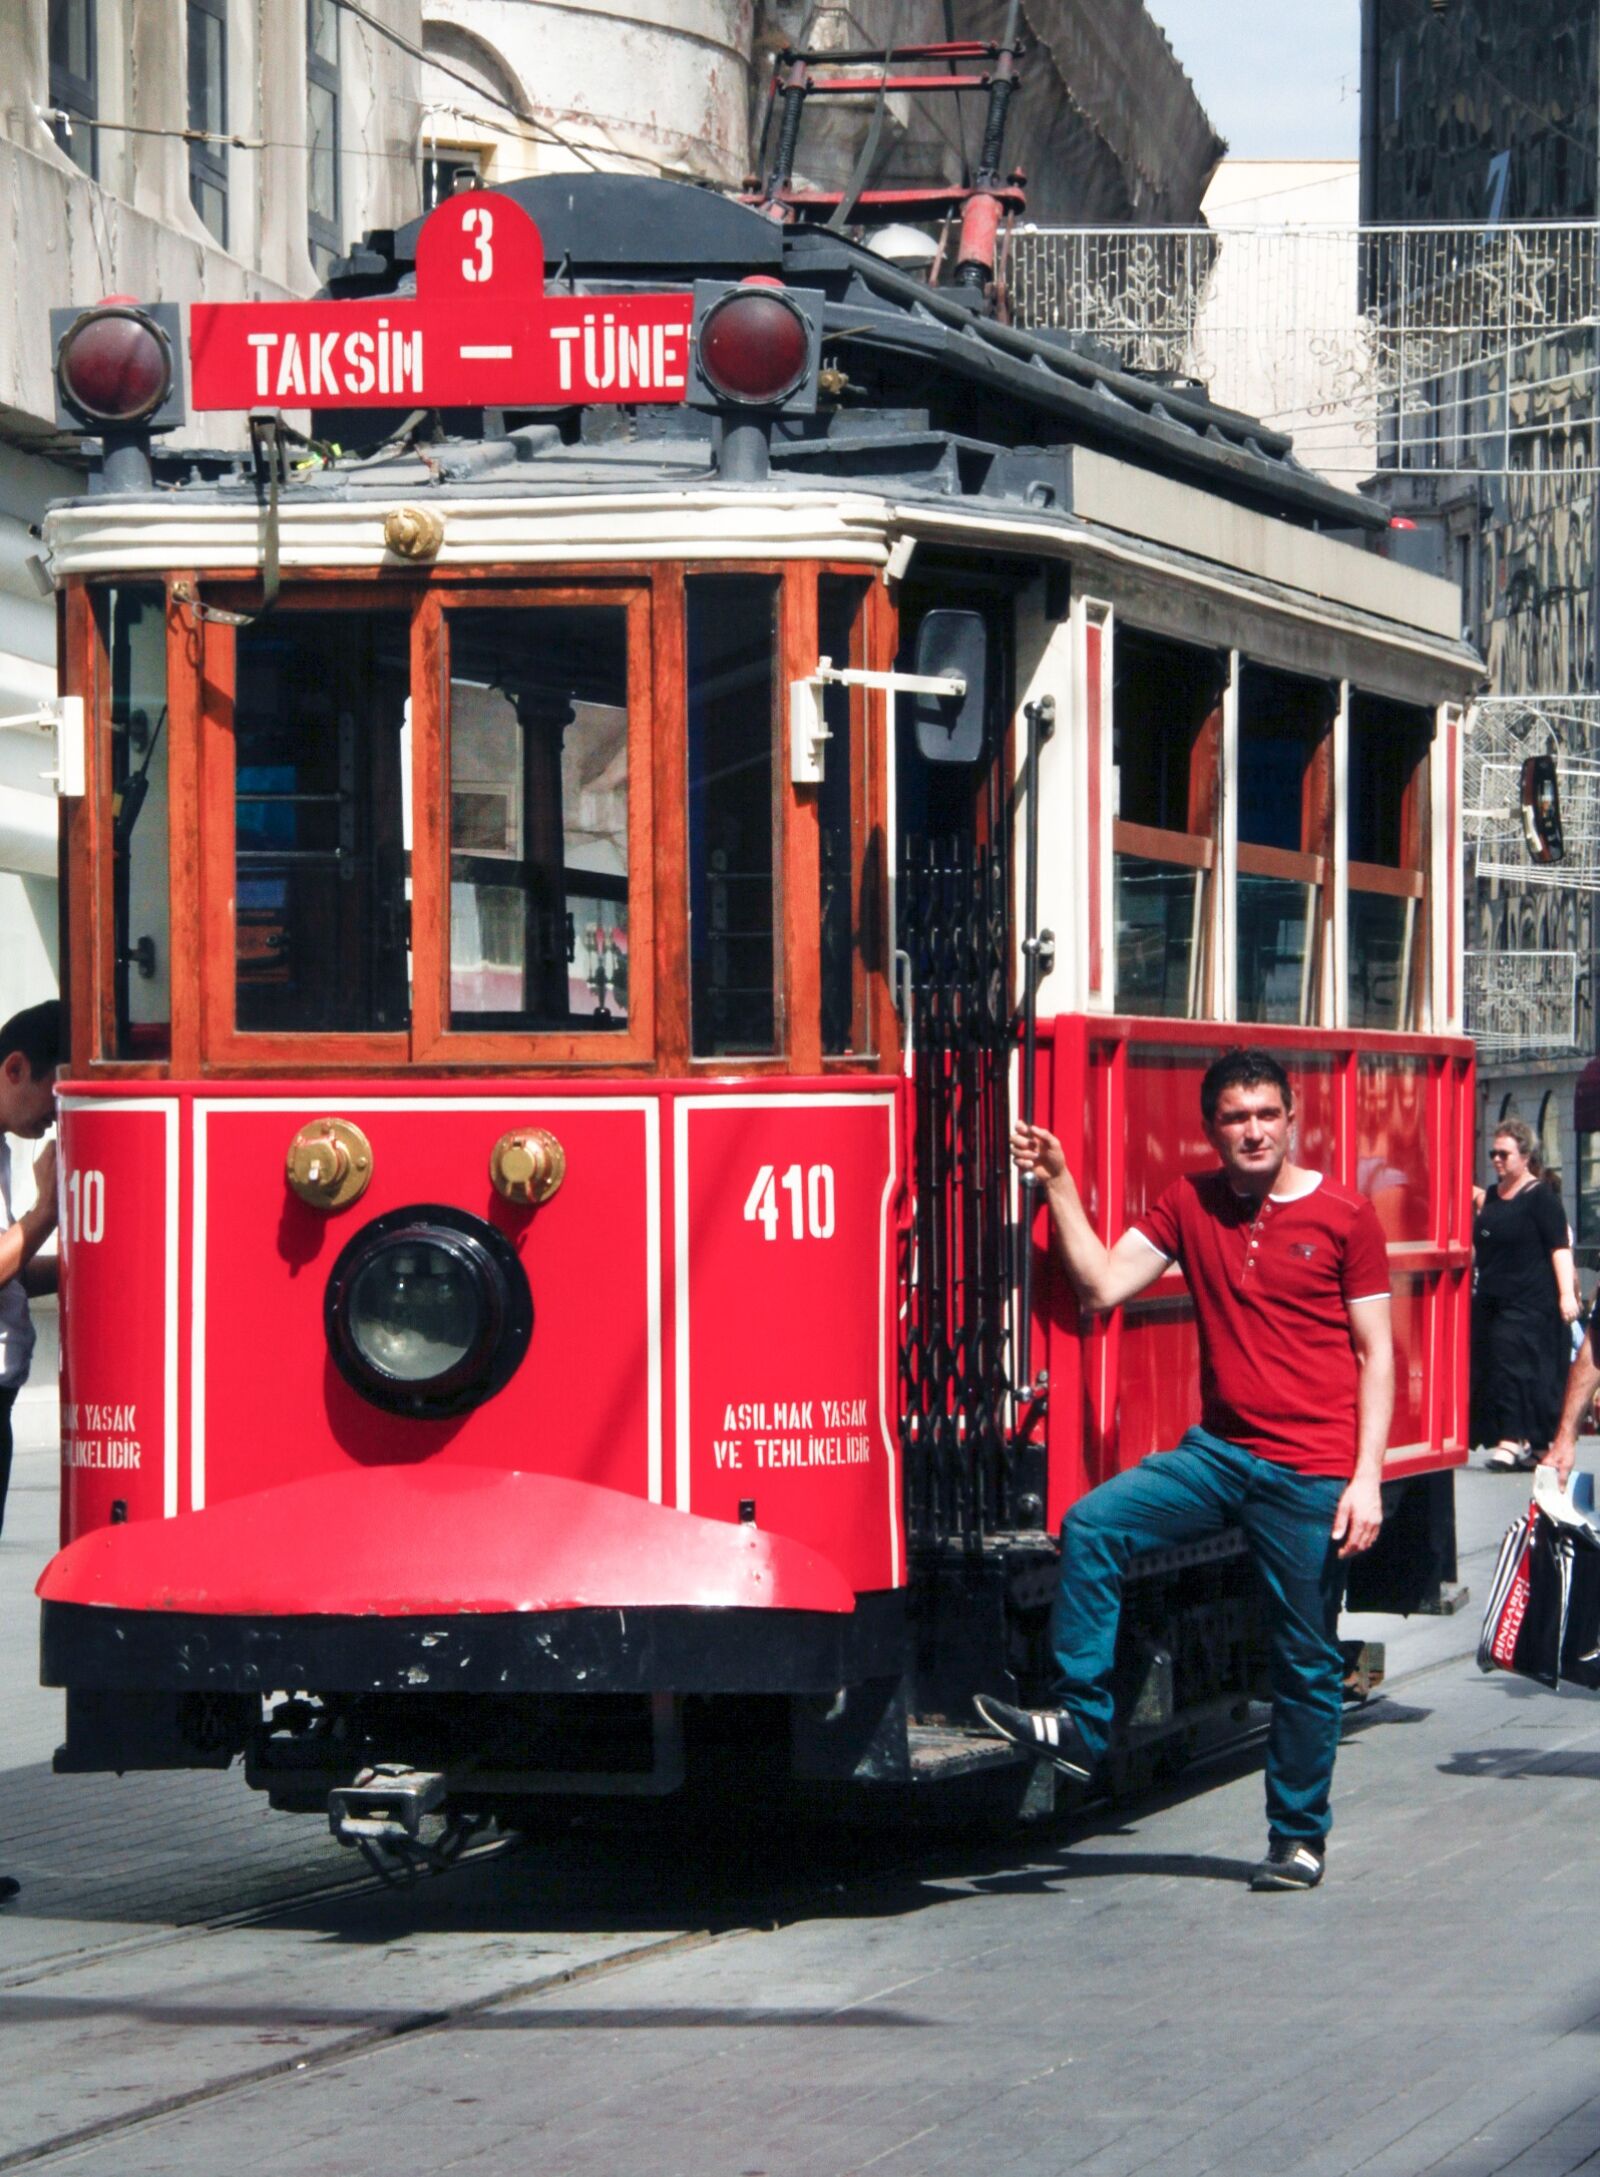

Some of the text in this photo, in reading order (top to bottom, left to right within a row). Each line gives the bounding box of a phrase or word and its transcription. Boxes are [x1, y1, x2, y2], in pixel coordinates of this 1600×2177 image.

[461, 208, 494, 283] 3
[247, 317, 424, 396] TAKSİM
[549, 313, 692, 391] TÜNE
[65, 1168, 105, 1244] 10
[743, 1163, 836, 1241] 410
[84, 1404, 136, 1433] YASAK
[713, 1432, 870, 1469] VE TEHLİKELİDİR
[723, 1399, 868, 1432] ASILMAK YASAK
